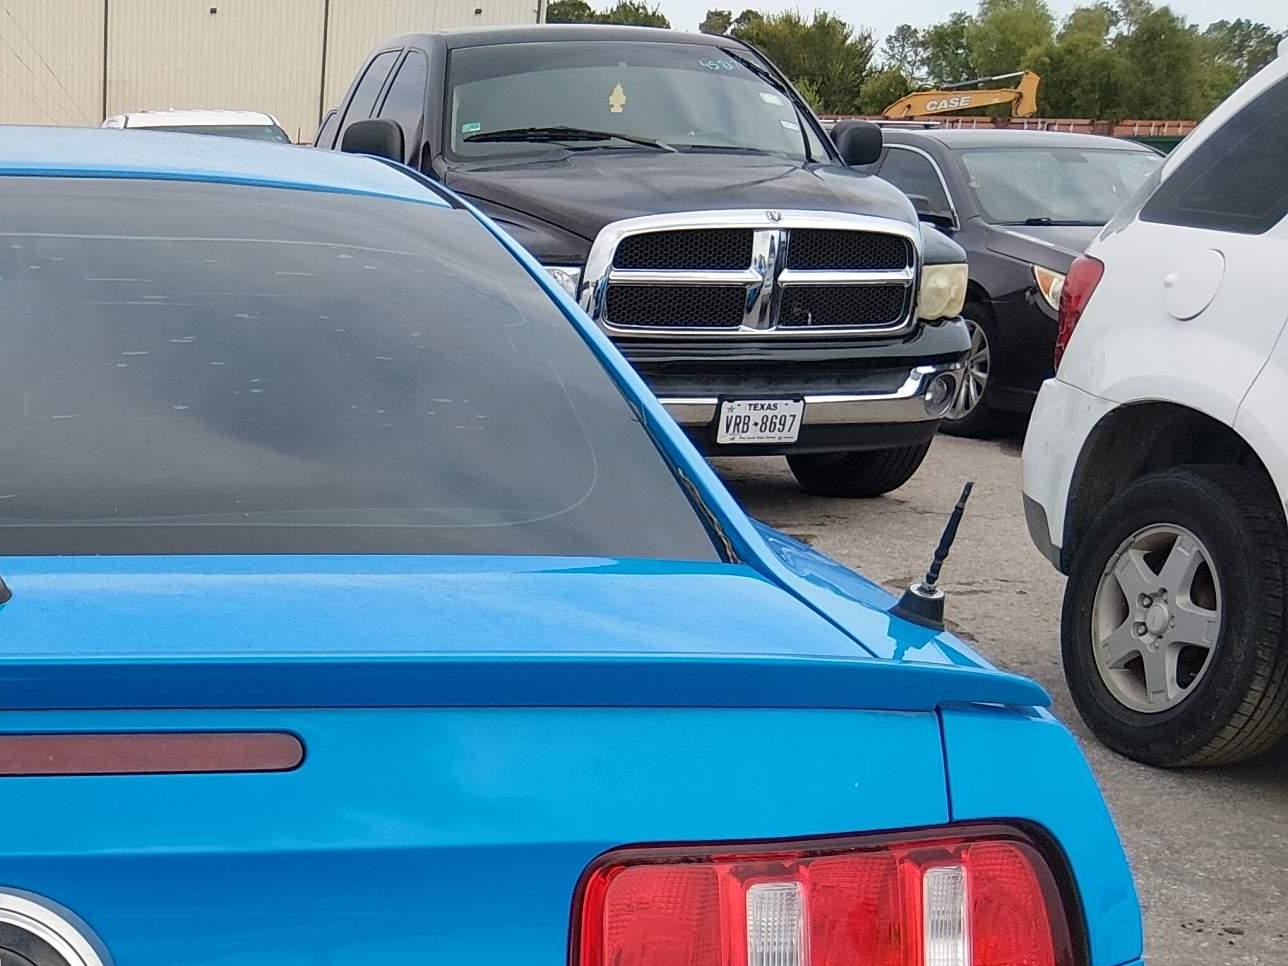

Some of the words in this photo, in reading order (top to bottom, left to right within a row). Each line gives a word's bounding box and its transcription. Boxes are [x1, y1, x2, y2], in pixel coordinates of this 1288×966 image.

[925, 95, 971, 112] CASE
[748, 403, 778, 411] TEXAS
[725, 415, 751, 434] VRB
[759, 414, 796, 433] 8697
